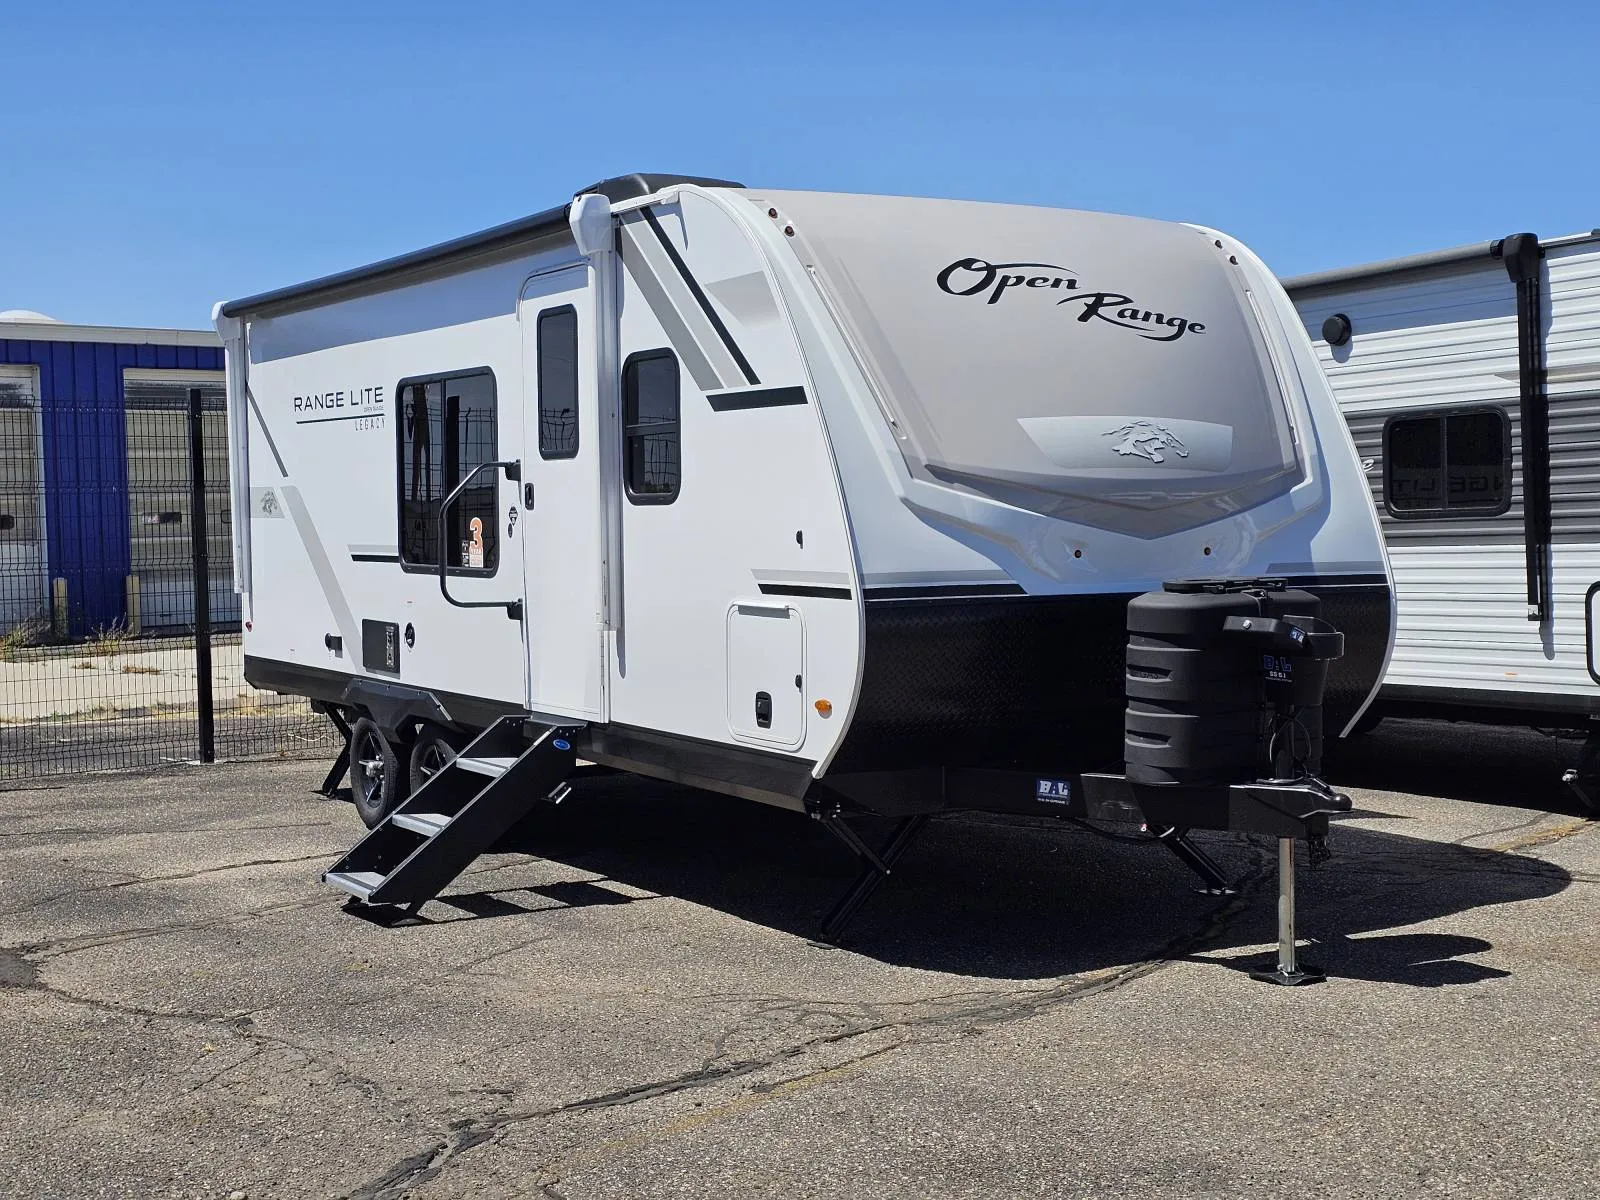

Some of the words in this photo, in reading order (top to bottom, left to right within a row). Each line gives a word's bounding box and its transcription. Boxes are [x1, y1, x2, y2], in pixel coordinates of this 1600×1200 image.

[936, 257, 1081, 305] Open
[1056, 292, 1206, 342] Range
[294, 391, 344, 412] RANGE
[350, 386, 384, 406] LITE
[355, 417, 385, 431] LEGACY
[470, 516, 483, 548] 3
[1039, 780, 1069, 796] BAL
